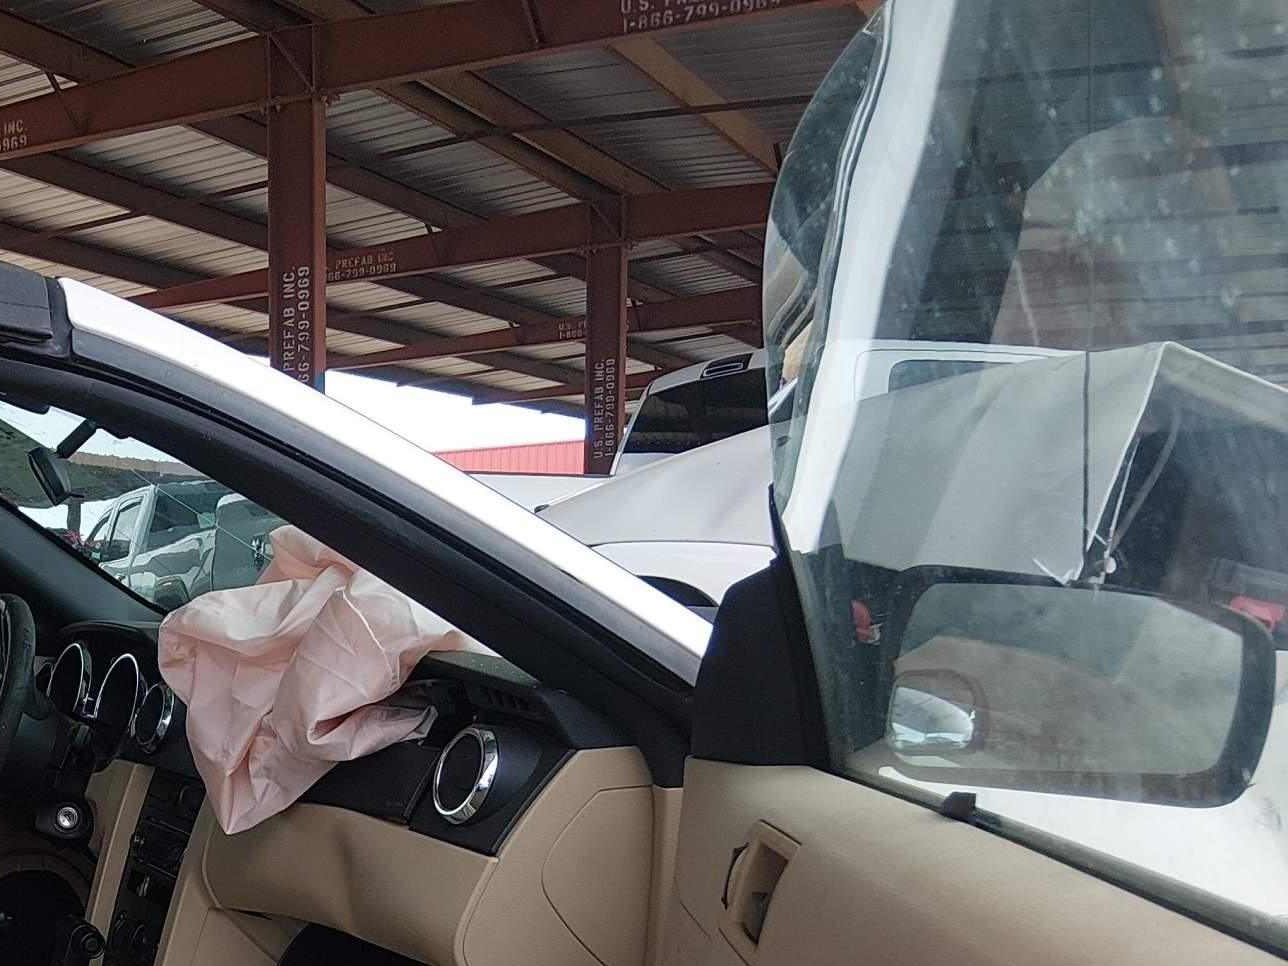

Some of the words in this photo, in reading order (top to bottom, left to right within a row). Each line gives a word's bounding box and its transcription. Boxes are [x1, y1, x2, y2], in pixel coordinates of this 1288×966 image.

[3, 119, 28, 136] INC.
[283, 266, 296, 299] INC.
[282, 306, 296, 372] PREFAB
[594, 359, 605, 381] INC.
[593, 387, 604, 431] PREFAB
[605, 358, 616, 457] 1-866-799-0969
[593, 437, 604, 459] U.S.
